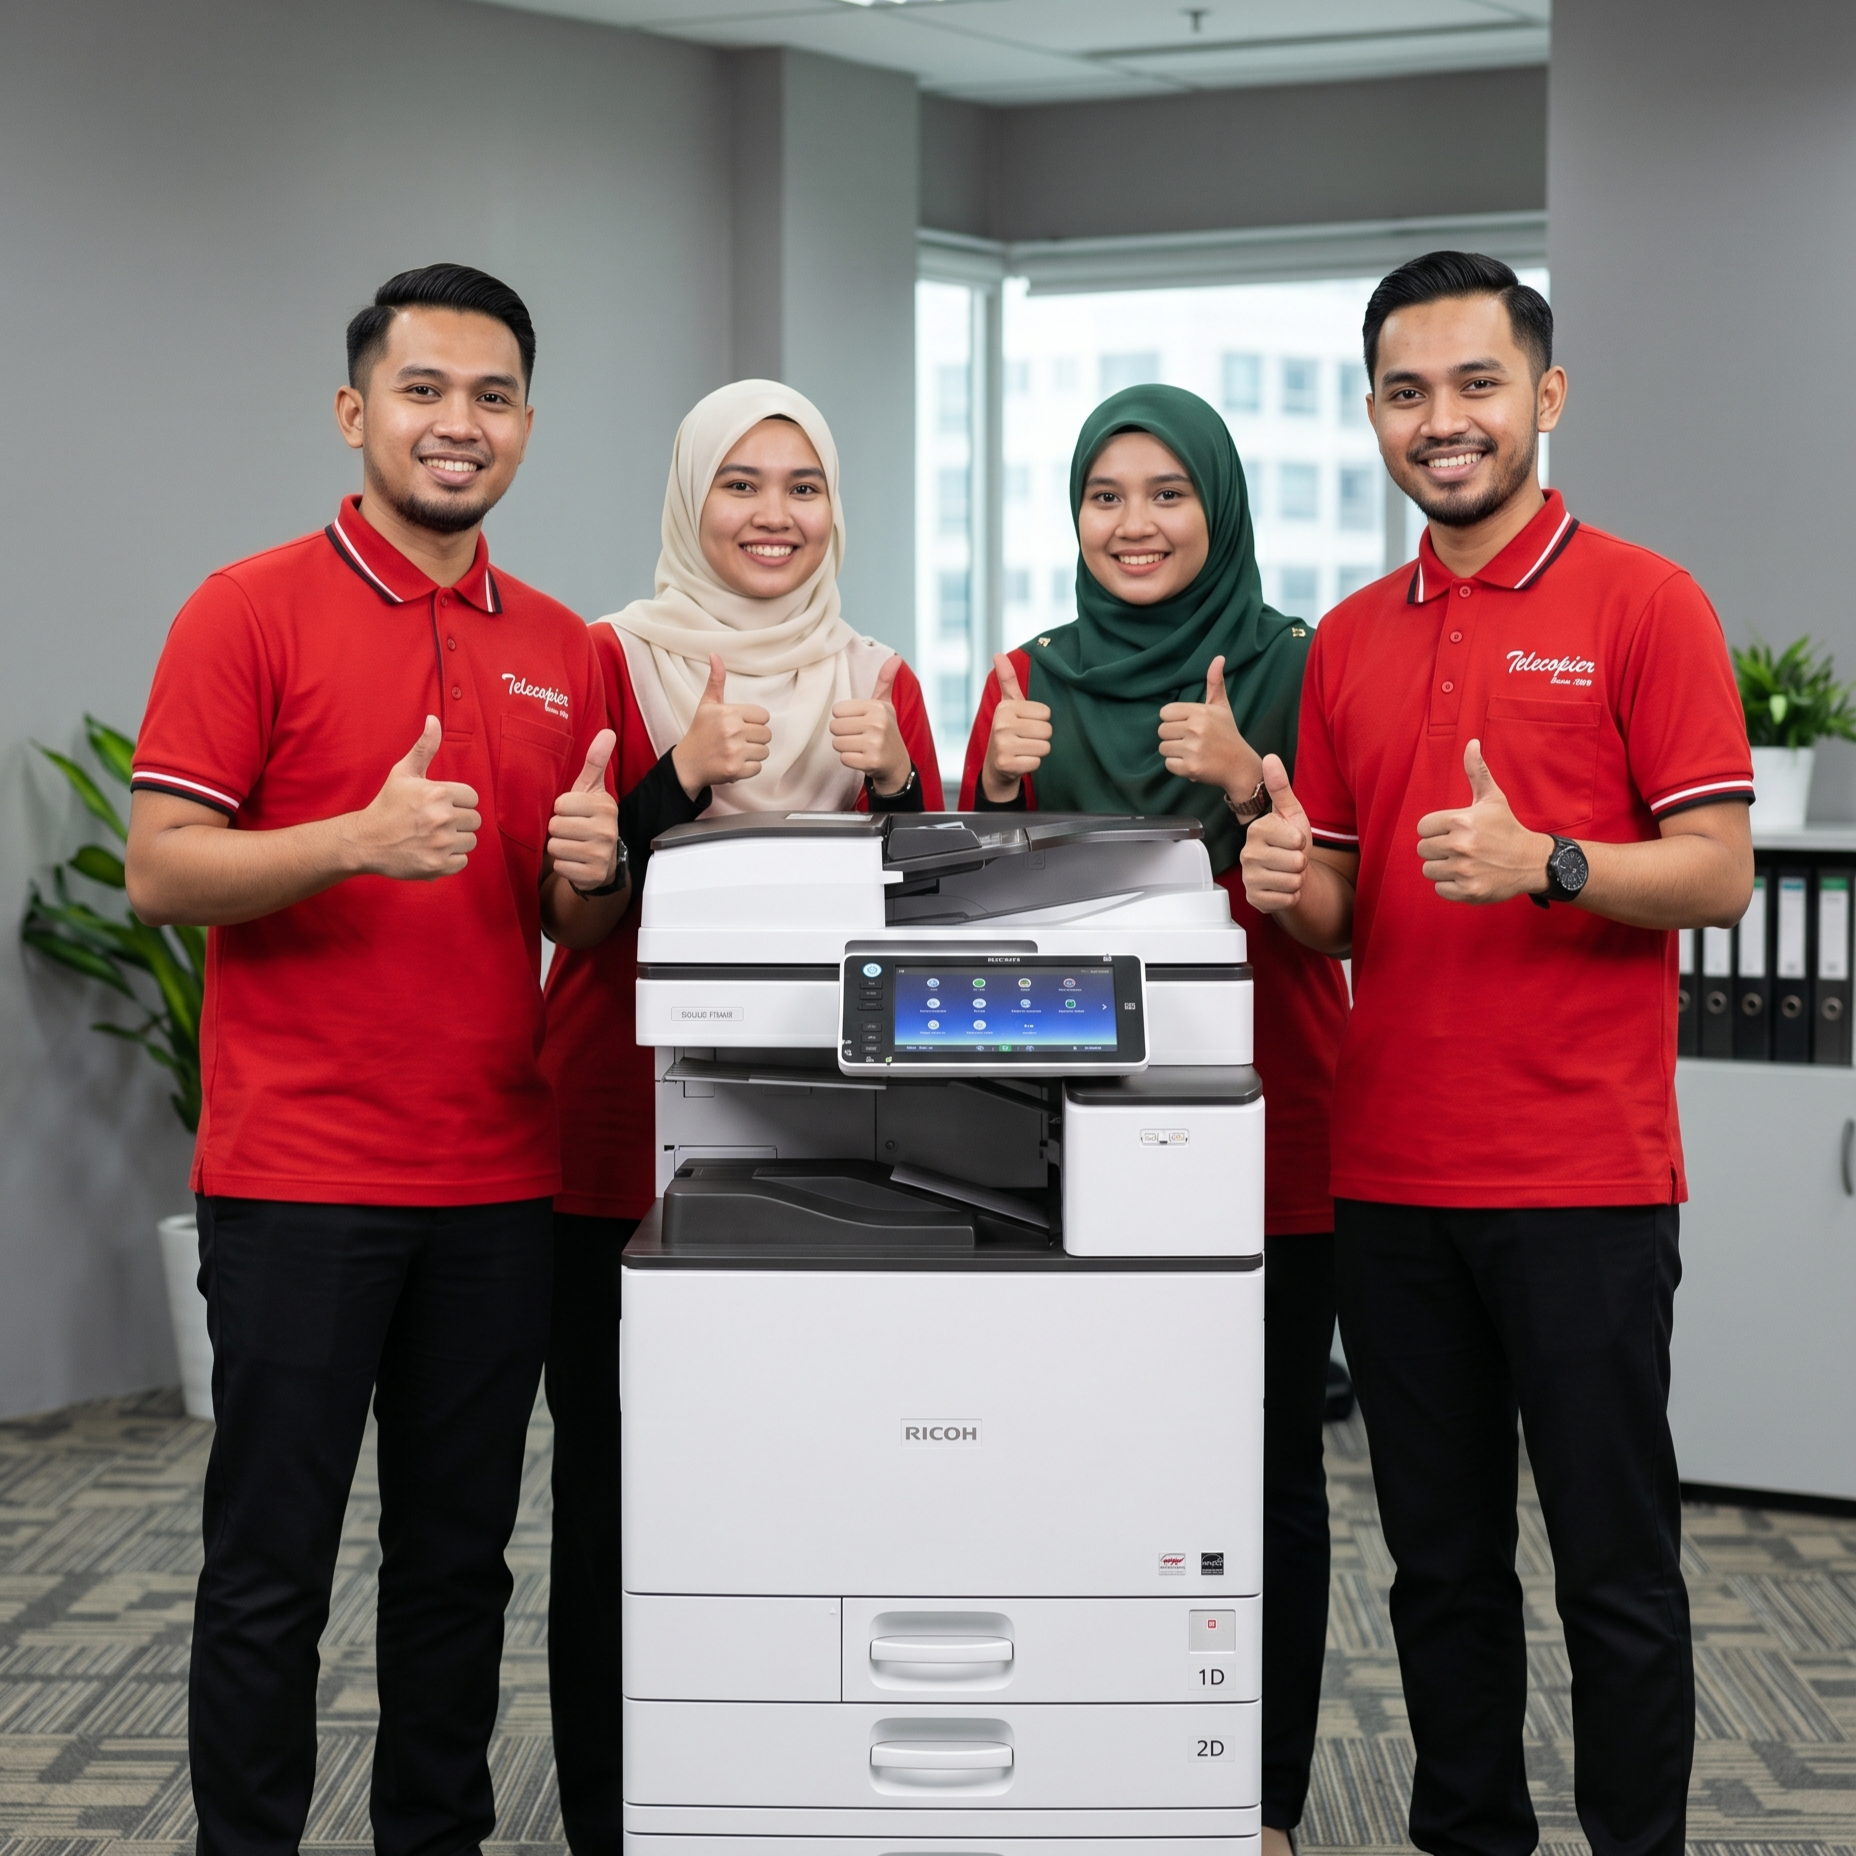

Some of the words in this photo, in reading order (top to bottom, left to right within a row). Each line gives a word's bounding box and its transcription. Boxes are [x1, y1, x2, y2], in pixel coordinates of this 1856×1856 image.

[1506, 650, 1595, 677] Telecopier
[501, 673, 568, 710] Telecopier
[905, 1426, 977, 1441] RICOH
[1198, 1668, 1225, 1686] 1D
[1197, 1739, 1225, 1757] 2D
